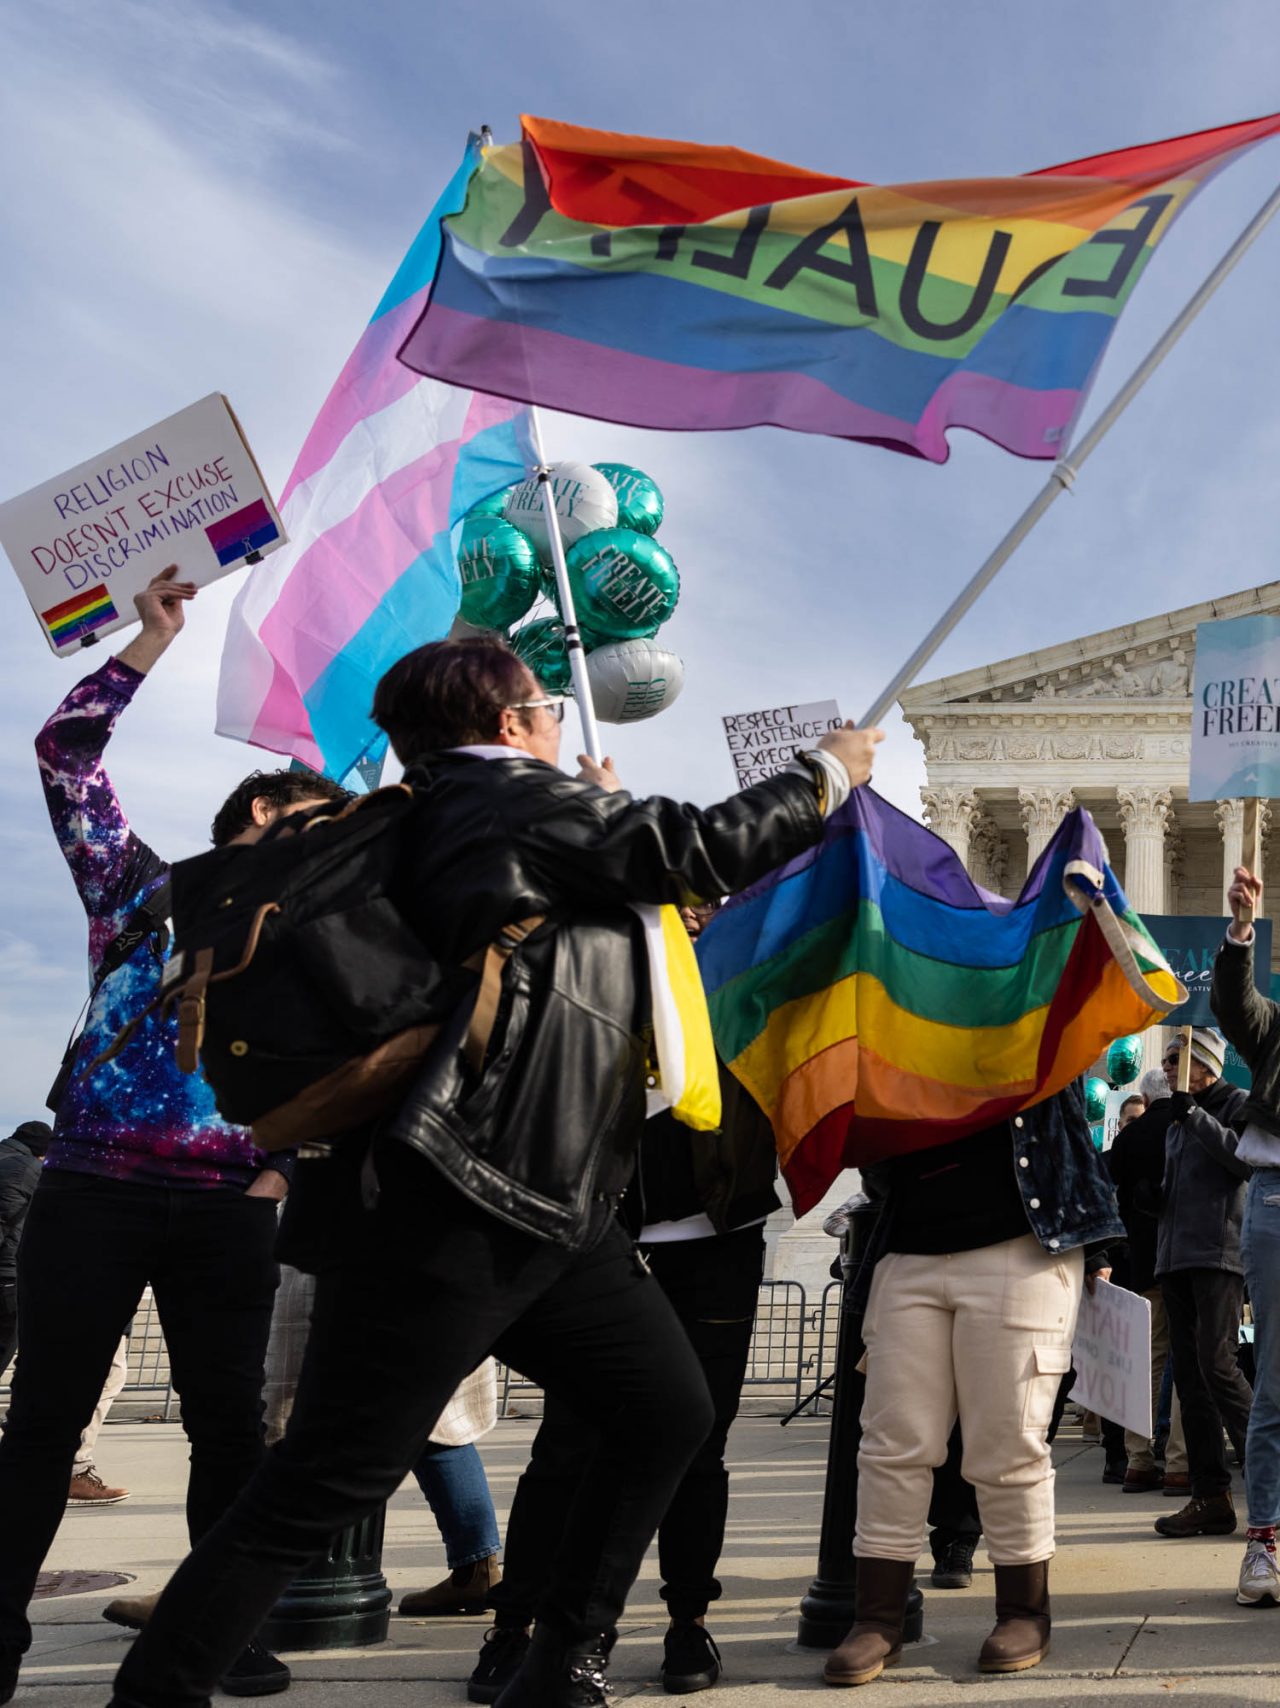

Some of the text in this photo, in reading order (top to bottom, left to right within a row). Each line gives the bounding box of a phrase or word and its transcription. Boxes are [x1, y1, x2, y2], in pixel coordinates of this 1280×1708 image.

[31, 456, 233, 575] DOESN'T EXCUSE
[54, 444, 169, 520] RELIGION
[63, 484, 239, 590] DISCRIMINATION
[581, 555, 654, 623] FREELY
[599, 544, 669, 613] CREATE
[722, 705, 799, 733] RESPECT
[727, 721, 824, 750] EXISTENCE
[732, 744, 801, 768] EXPECT
[737, 763, 788, 788] RESIS
